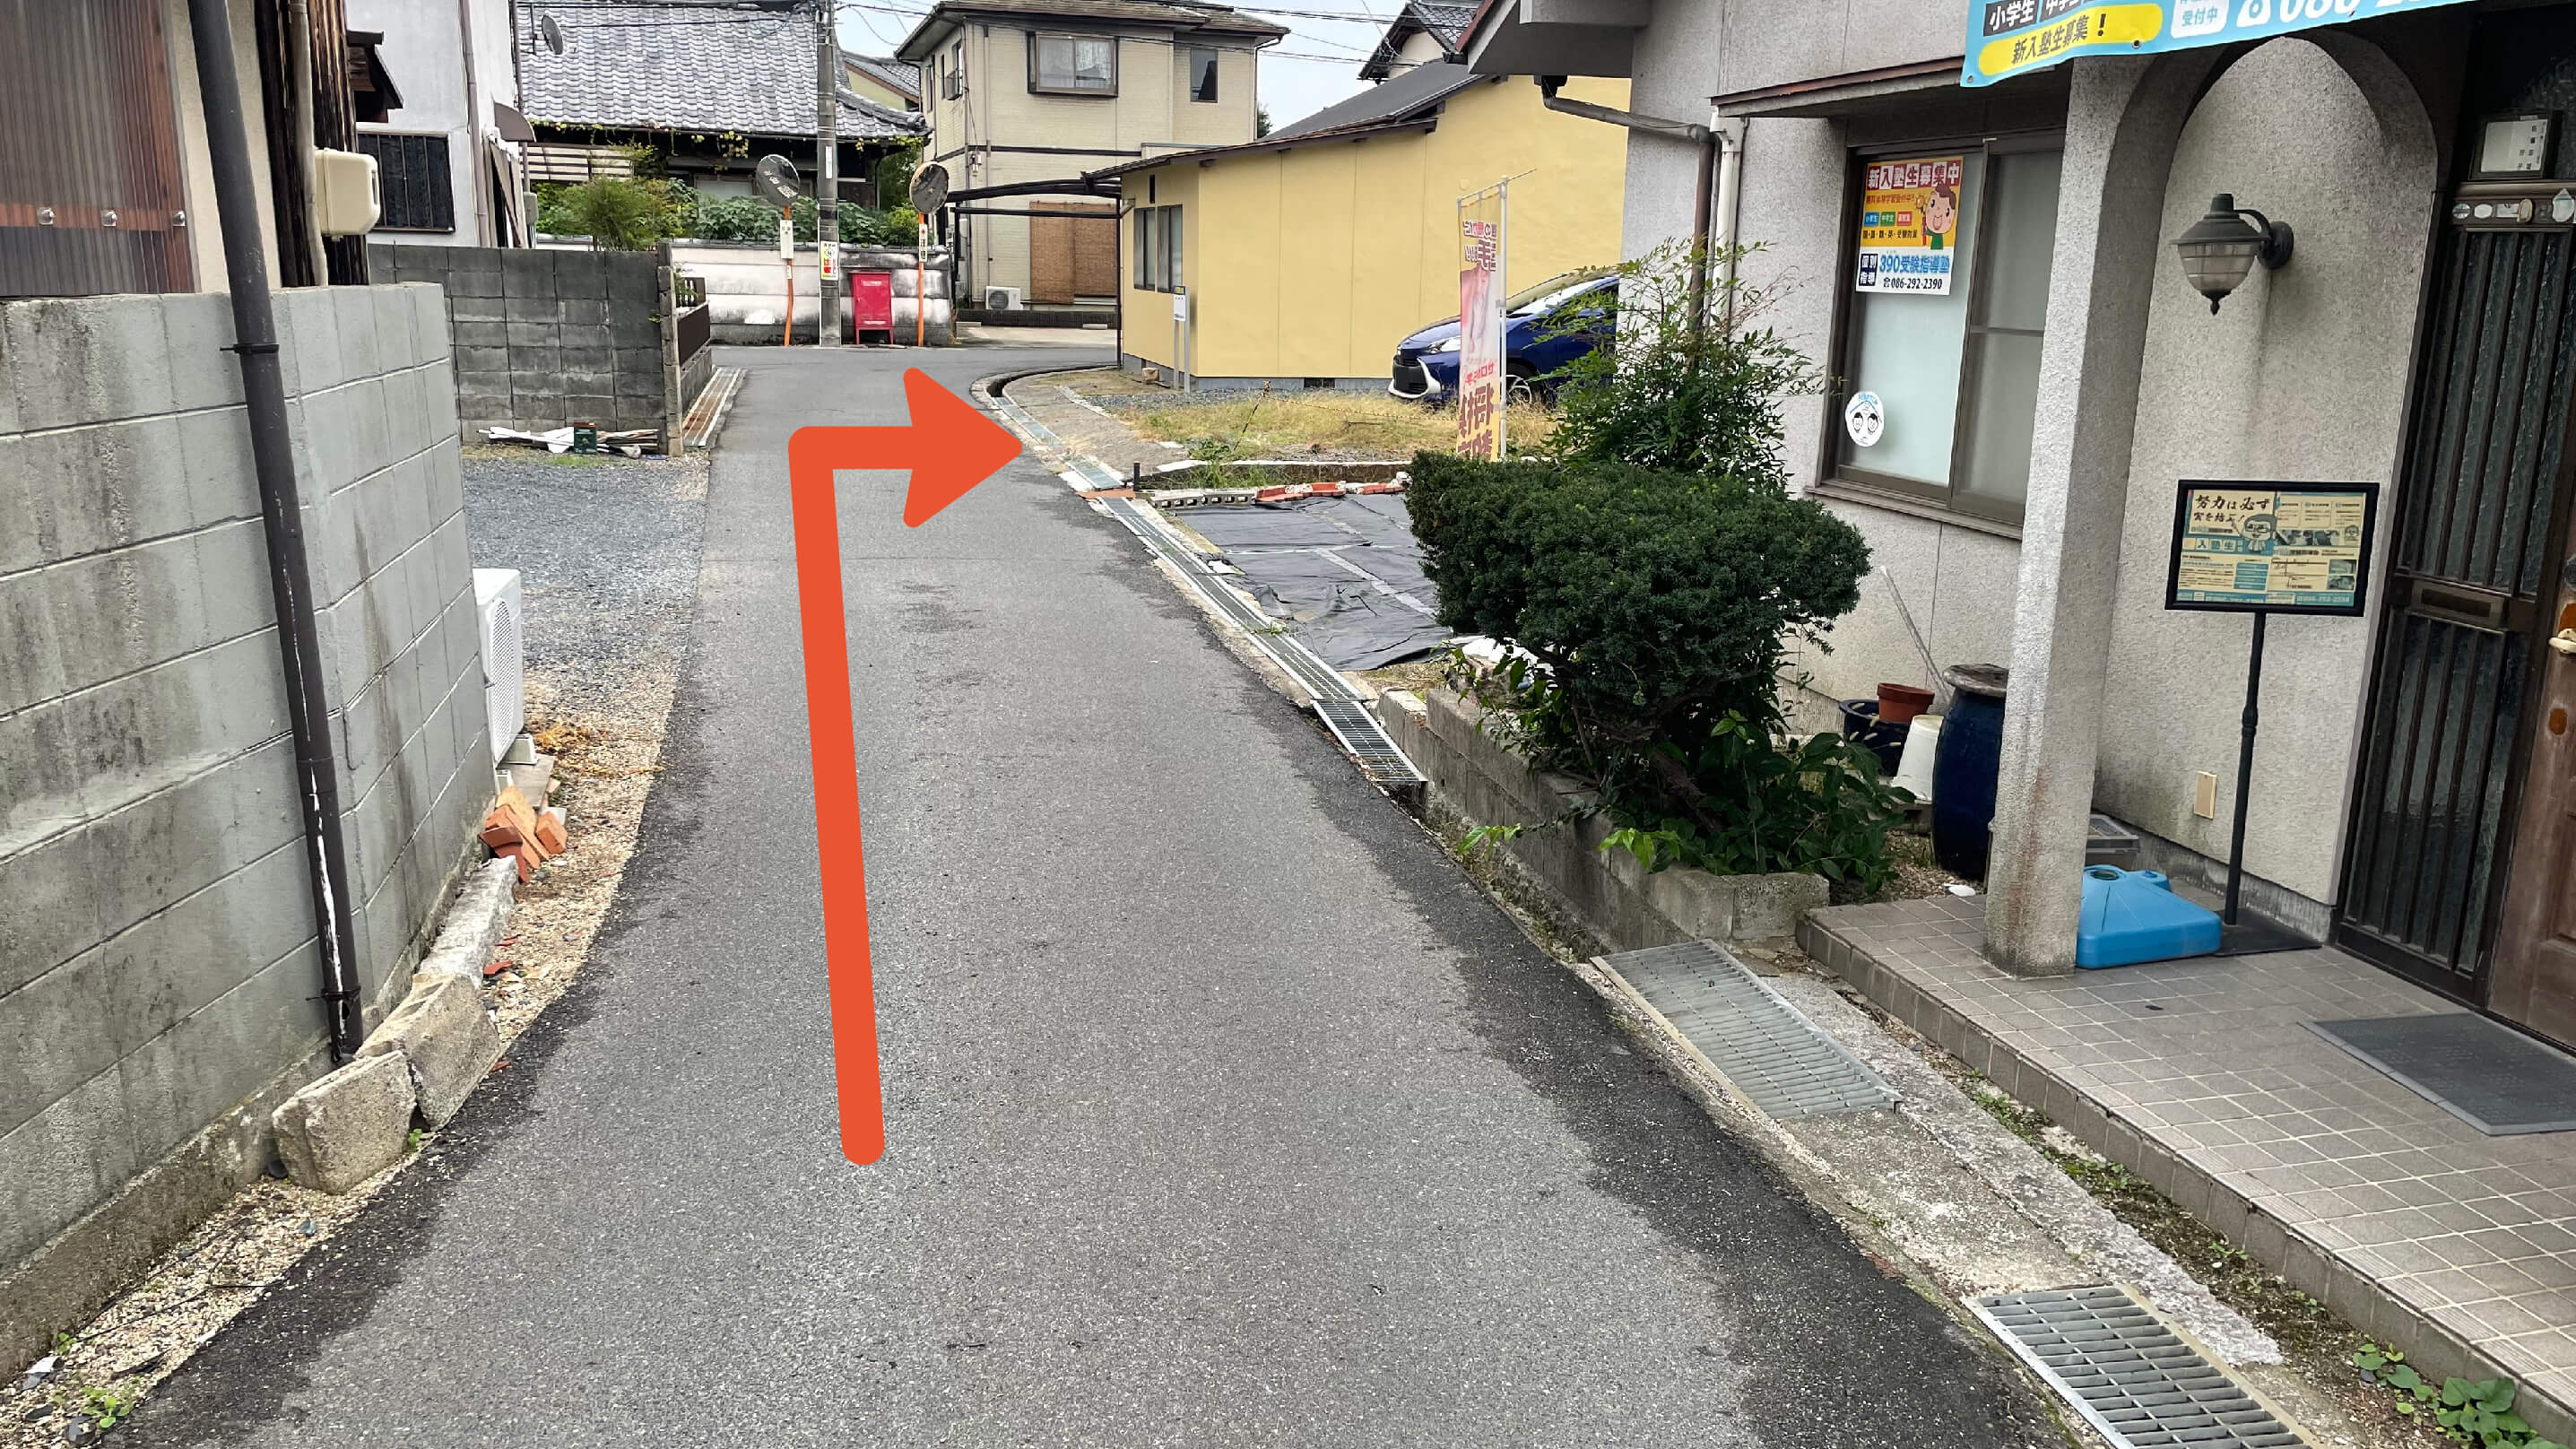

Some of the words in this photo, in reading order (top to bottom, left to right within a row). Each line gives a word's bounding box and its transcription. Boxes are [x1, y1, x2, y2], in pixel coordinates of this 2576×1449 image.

[1989, 0, 2034, 31] 小学生
[2181, 8, 2218, 27] 受付中
[1869, 162, 1960, 188] 新入塾生募集中
[1879, 255, 1950, 273] 390受験指導塾
[2195, 494, 2270, 510] 努力は必ず
